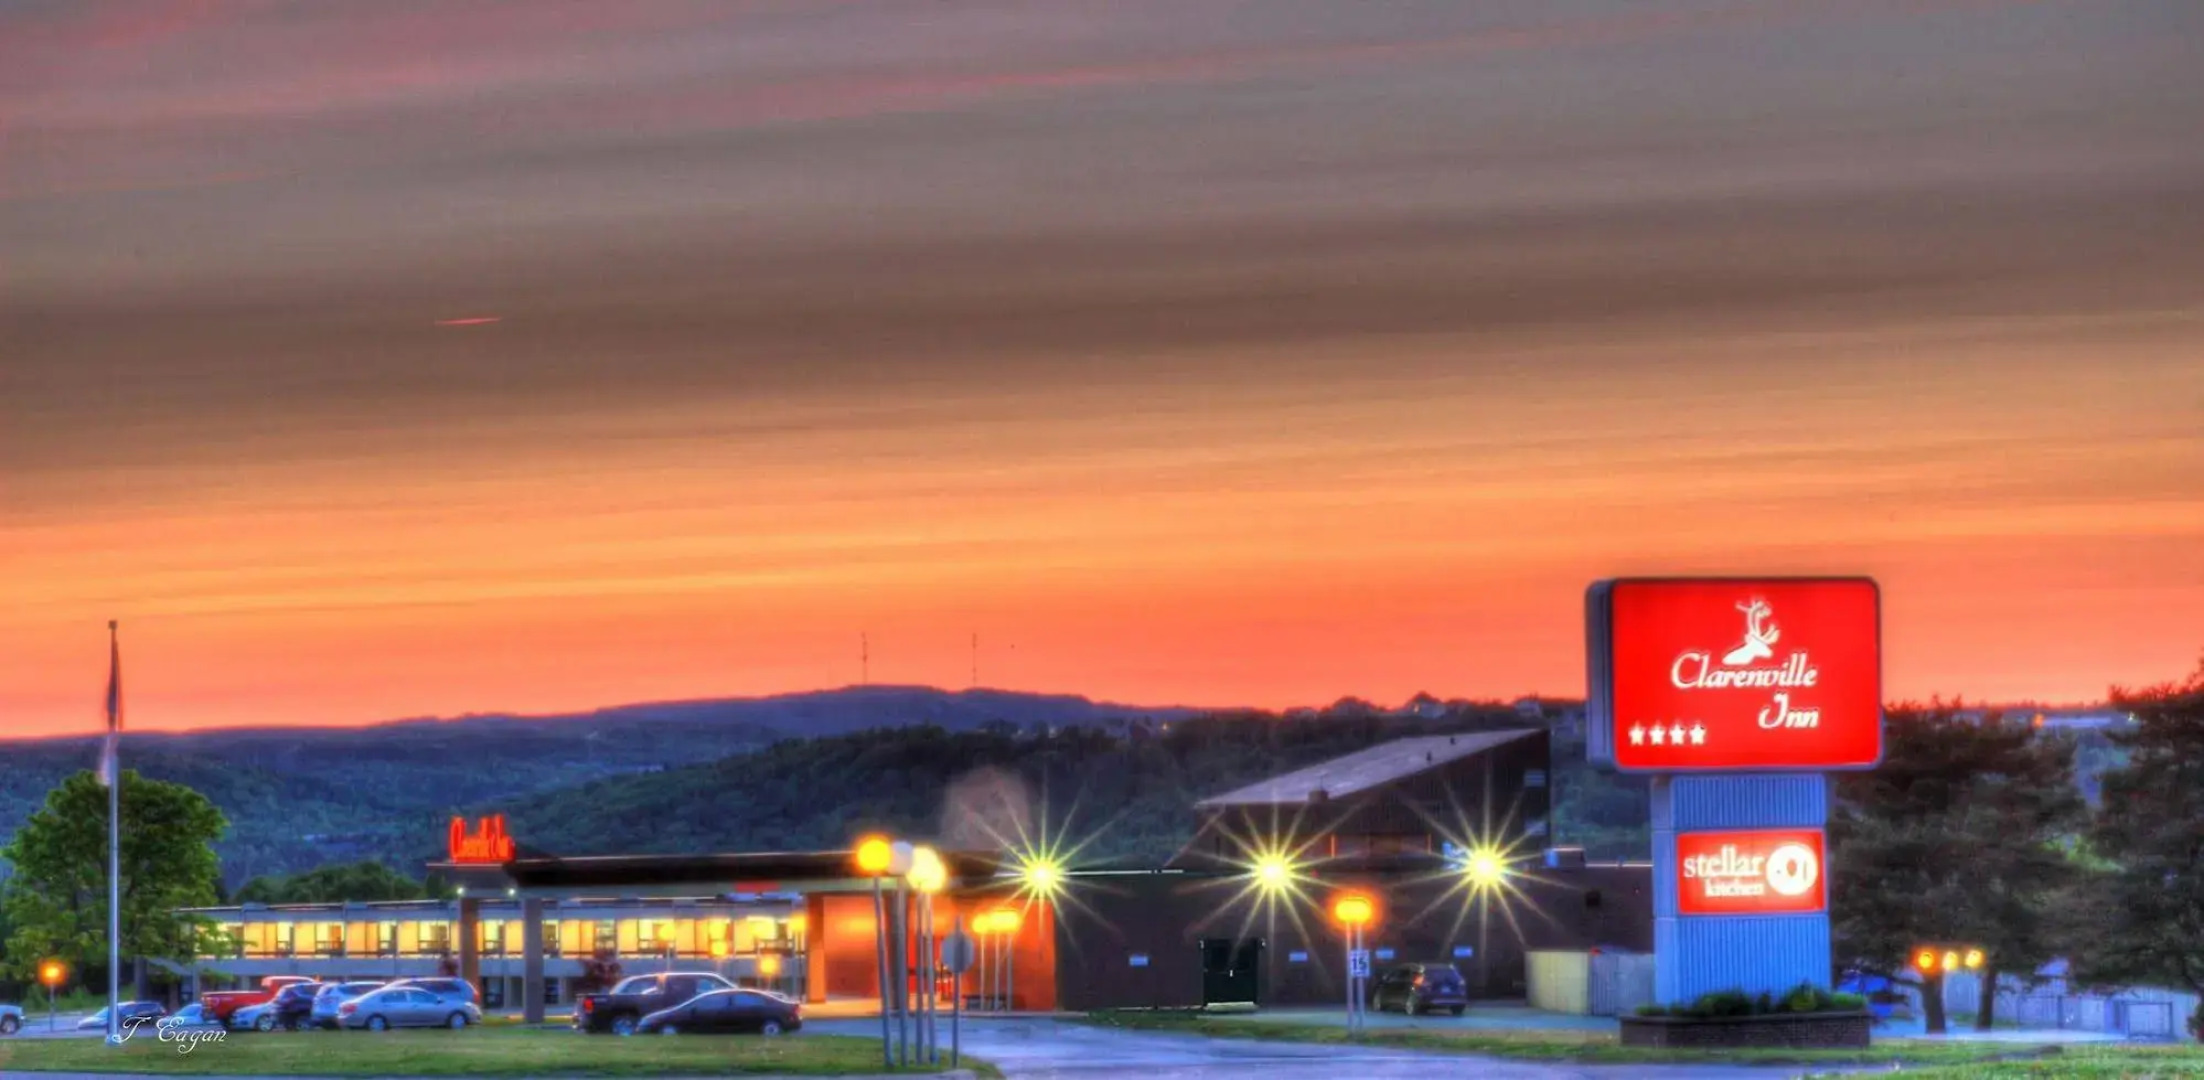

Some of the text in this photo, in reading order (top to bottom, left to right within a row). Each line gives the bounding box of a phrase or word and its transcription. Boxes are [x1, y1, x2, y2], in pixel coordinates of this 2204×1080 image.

[1671, 652, 1818, 688] Clarenville
[1757, 692, 1820, 728] Inn
[1683, 844, 1765, 878] stellar
